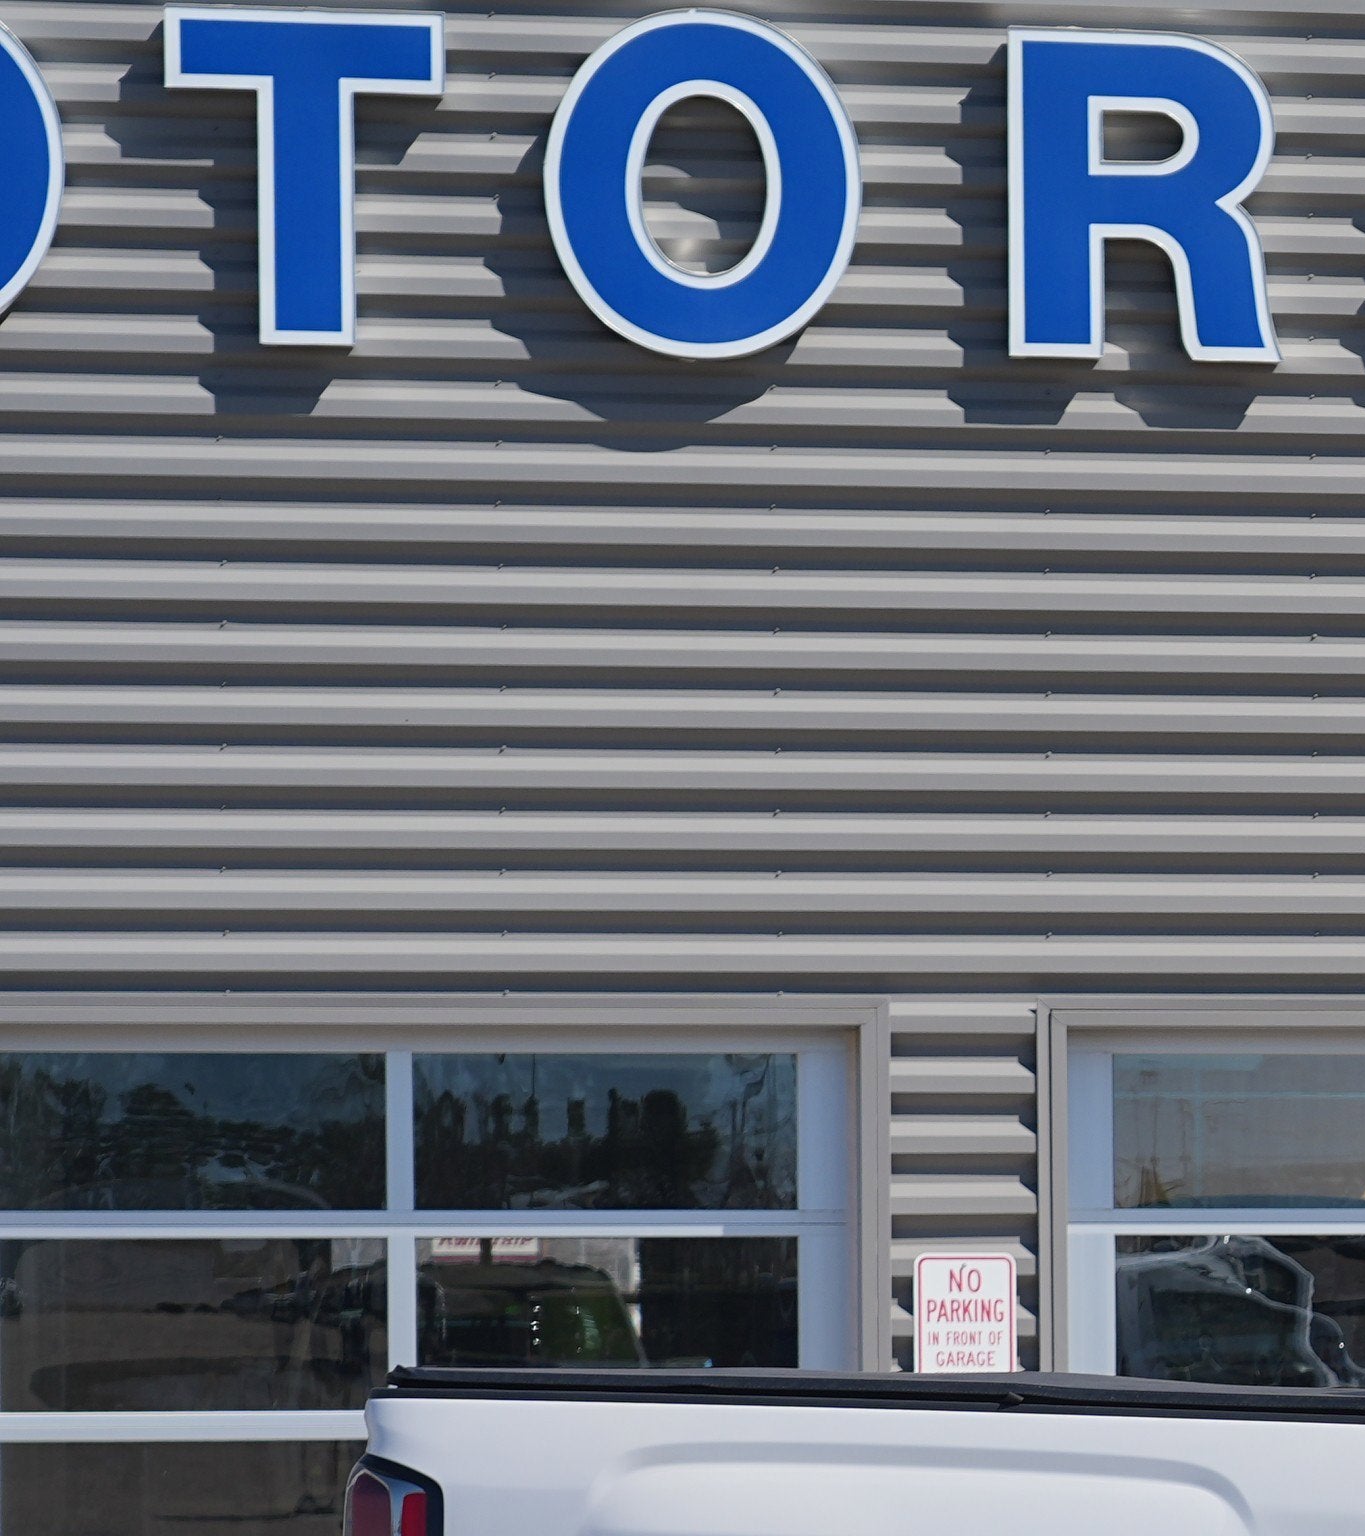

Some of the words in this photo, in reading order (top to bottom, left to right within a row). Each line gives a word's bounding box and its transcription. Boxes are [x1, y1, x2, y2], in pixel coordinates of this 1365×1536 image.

[949, 1269, 982, 1292] NO
[926, 1299, 1004, 1322] PARKING
[927, 1331, 939, 1346] IN
[946, 1331, 982, 1346] FRONT
[988, 1331, 1003, 1346] OF
[936, 1350, 996, 1367] GARAGE
